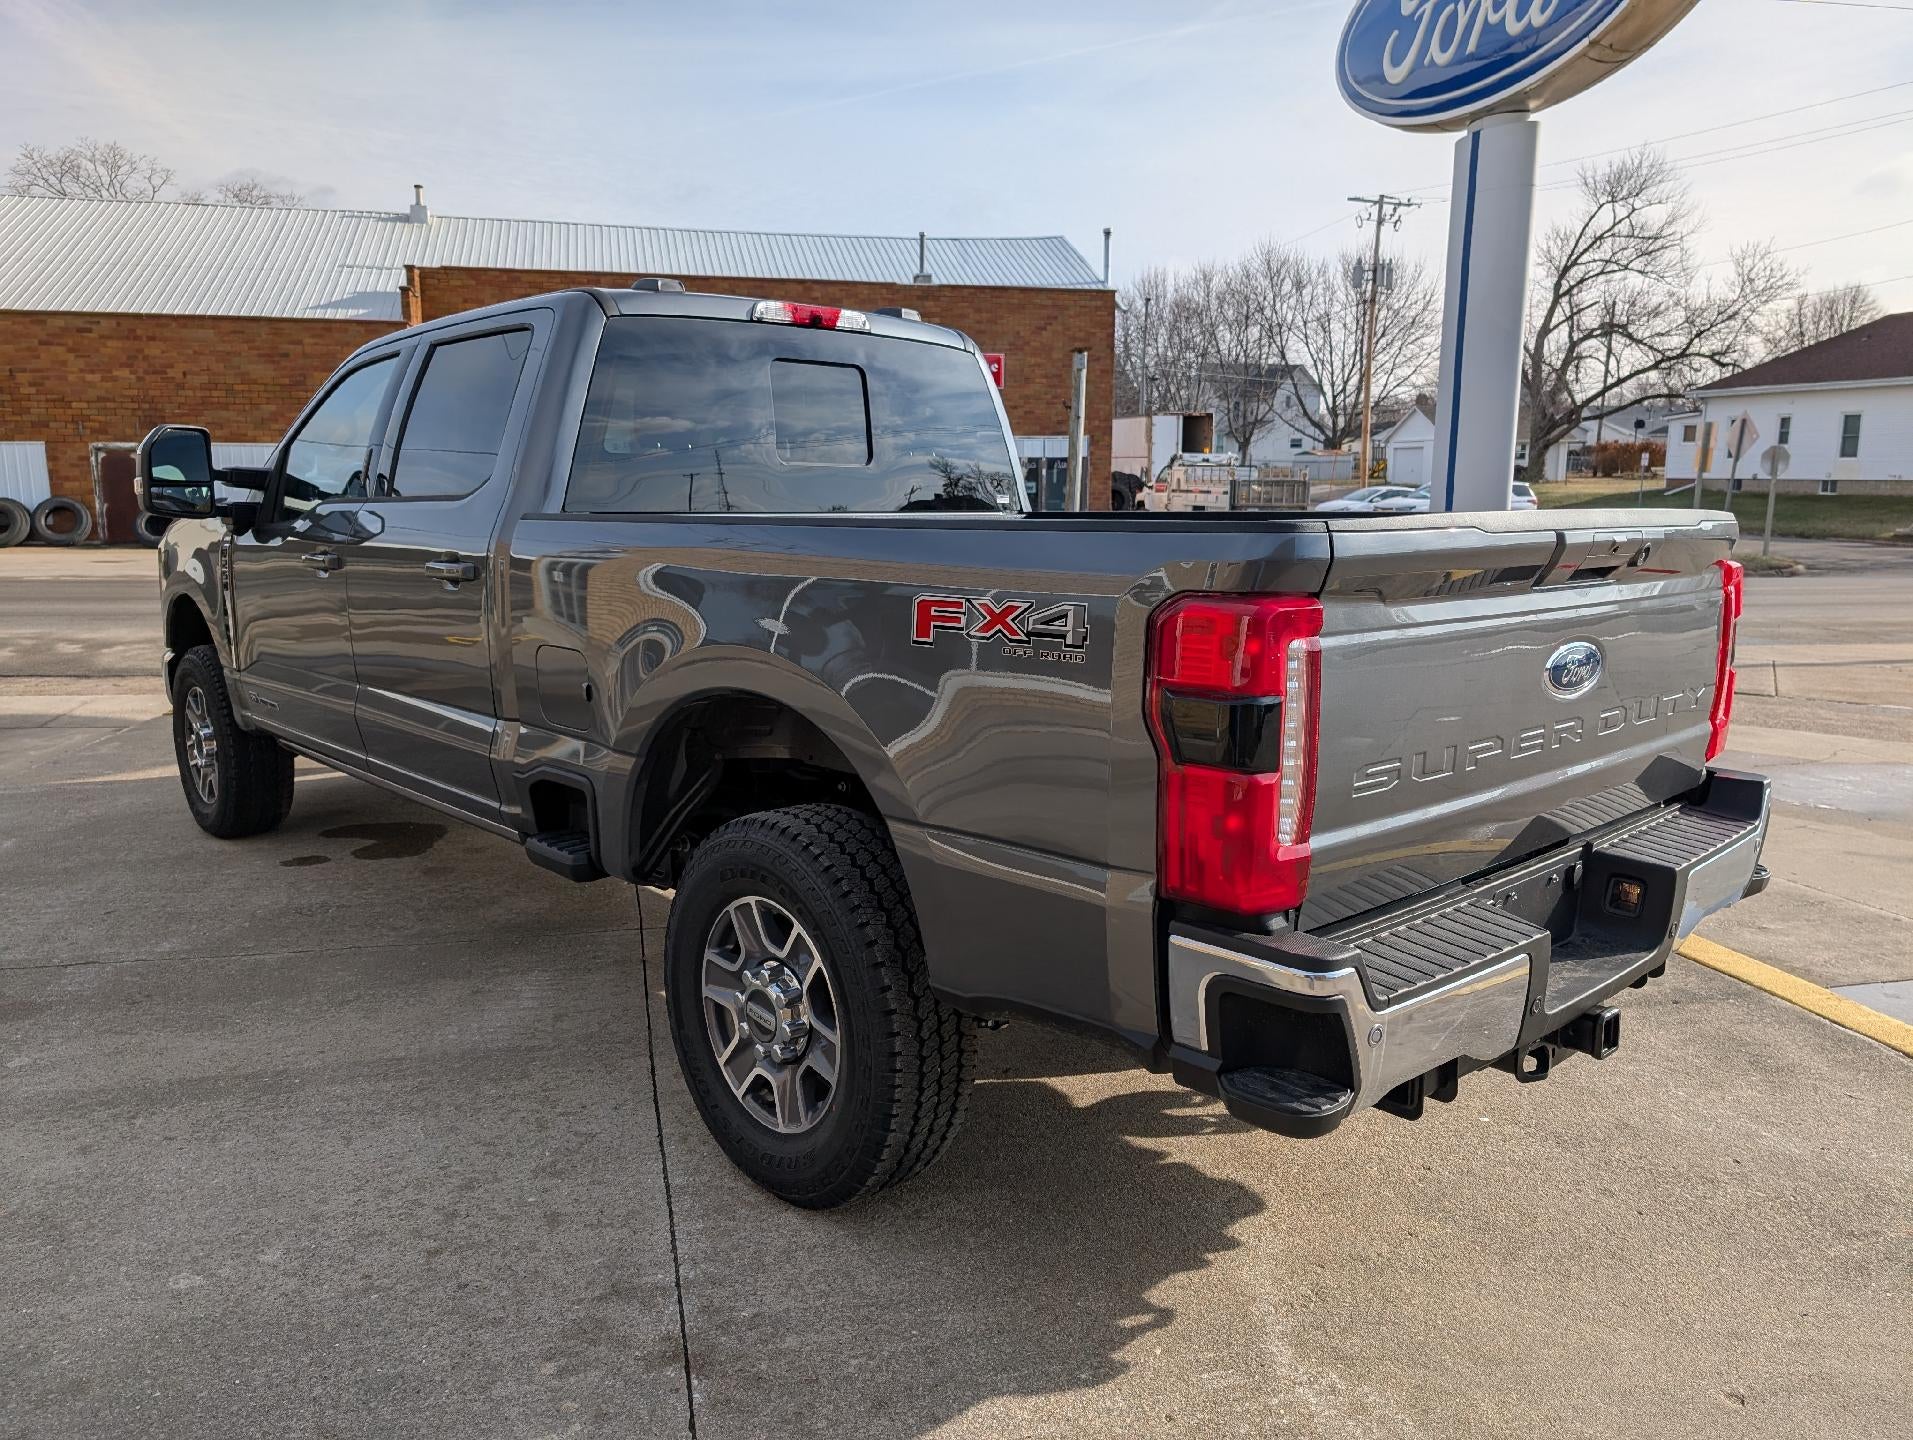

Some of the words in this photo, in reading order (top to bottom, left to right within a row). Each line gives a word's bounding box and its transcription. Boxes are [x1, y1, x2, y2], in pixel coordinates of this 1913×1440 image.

[911, 593, 1090, 651] FX4
[1002, 647, 1034, 659] OFF
[1039, 651, 1086, 664] ROAD
[1561, 654, 1594, 685] Ford
[1352, 715, 1585, 799] SUPER
[1597, 687, 1706, 736] DUTY
